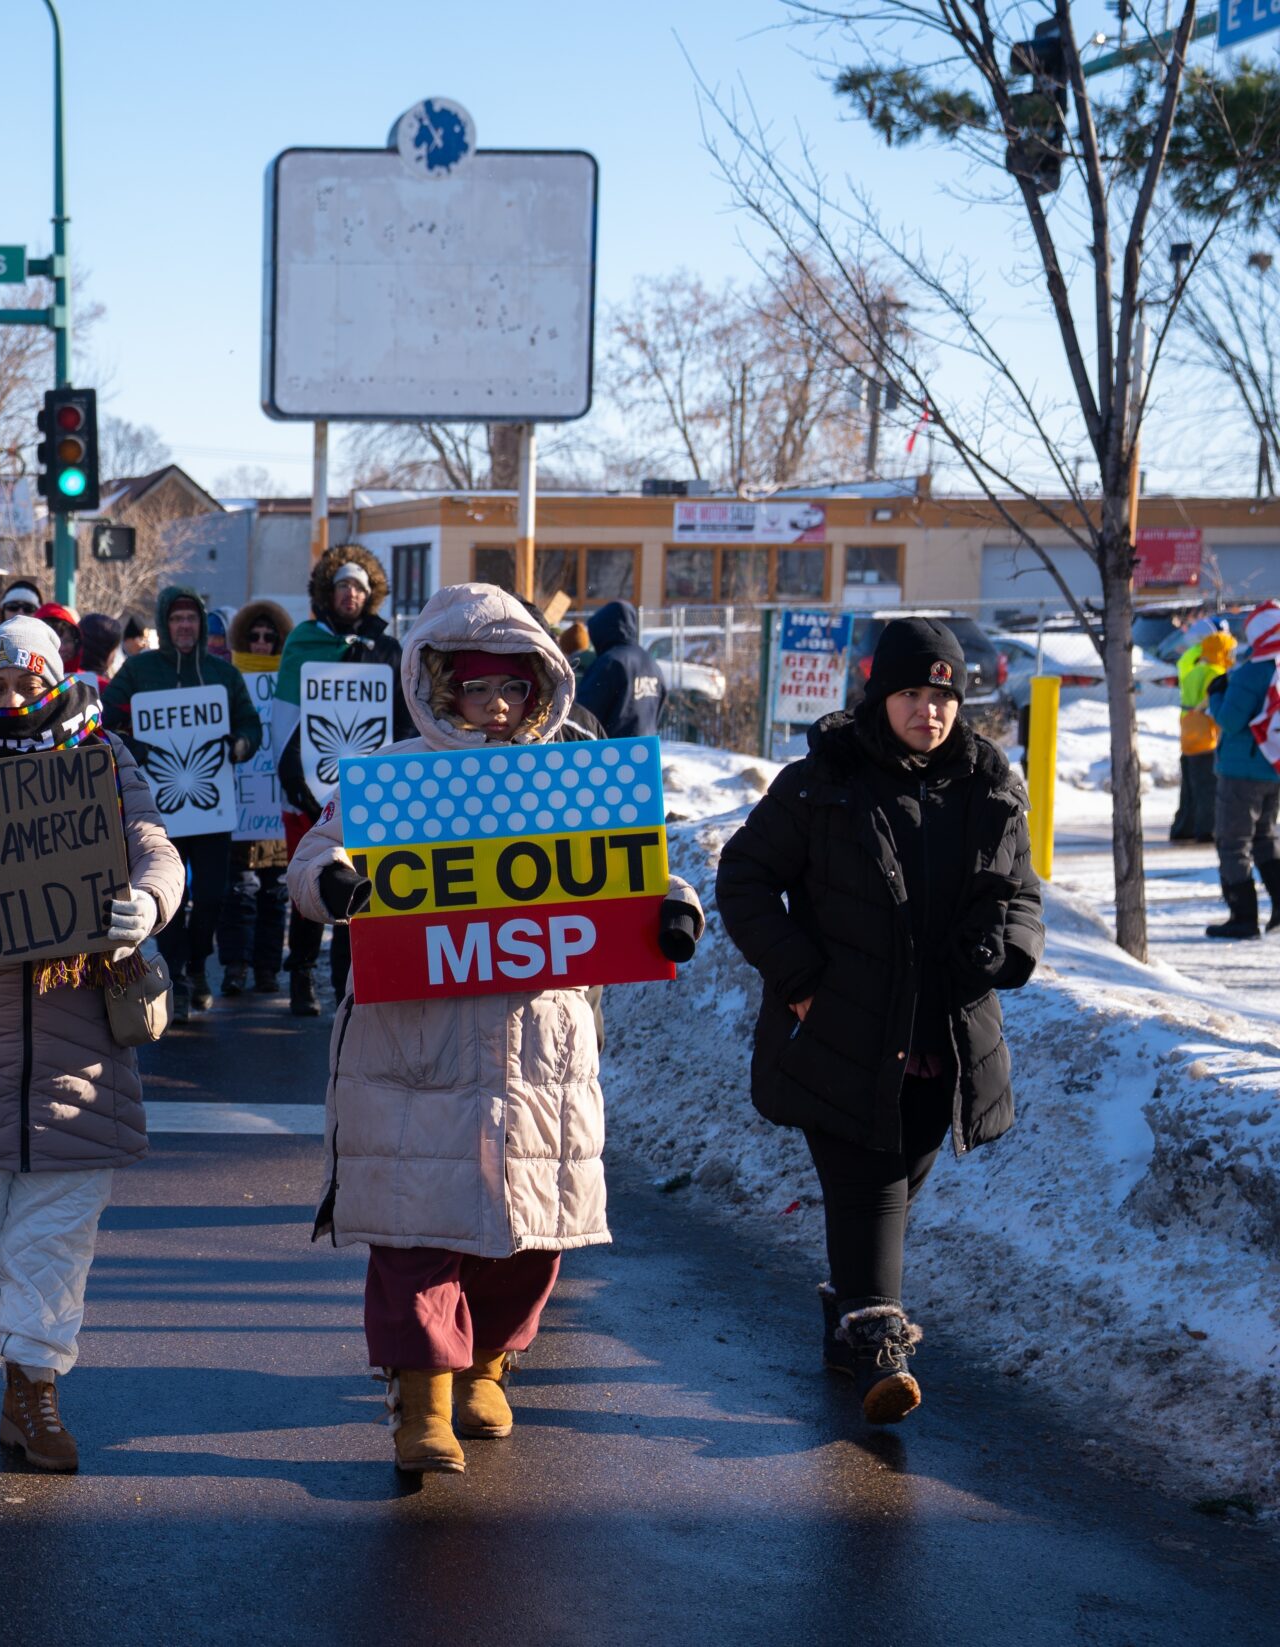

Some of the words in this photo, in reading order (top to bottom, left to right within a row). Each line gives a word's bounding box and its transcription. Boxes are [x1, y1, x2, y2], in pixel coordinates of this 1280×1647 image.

[1228, 0, 1240, 30] E
[731, 505, 755, 521] SALES
[791, 614, 842, 628] HAVE
[809, 627, 822, 638] A
[795, 637, 835, 650] JOB
[784, 655, 819, 668] GET
[827, 657, 839, 670] A
[792, 671, 830, 683] CAR
[307, 679, 387, 703] DEFEND
[781, 683, 838, 697] HERE!
[138, 702, 222, 731] DEFEND
[0, 804, 109, 865] AMERICA
[496, 832, 659, 902] OUT
[425, 915, 596, 985] MSP
